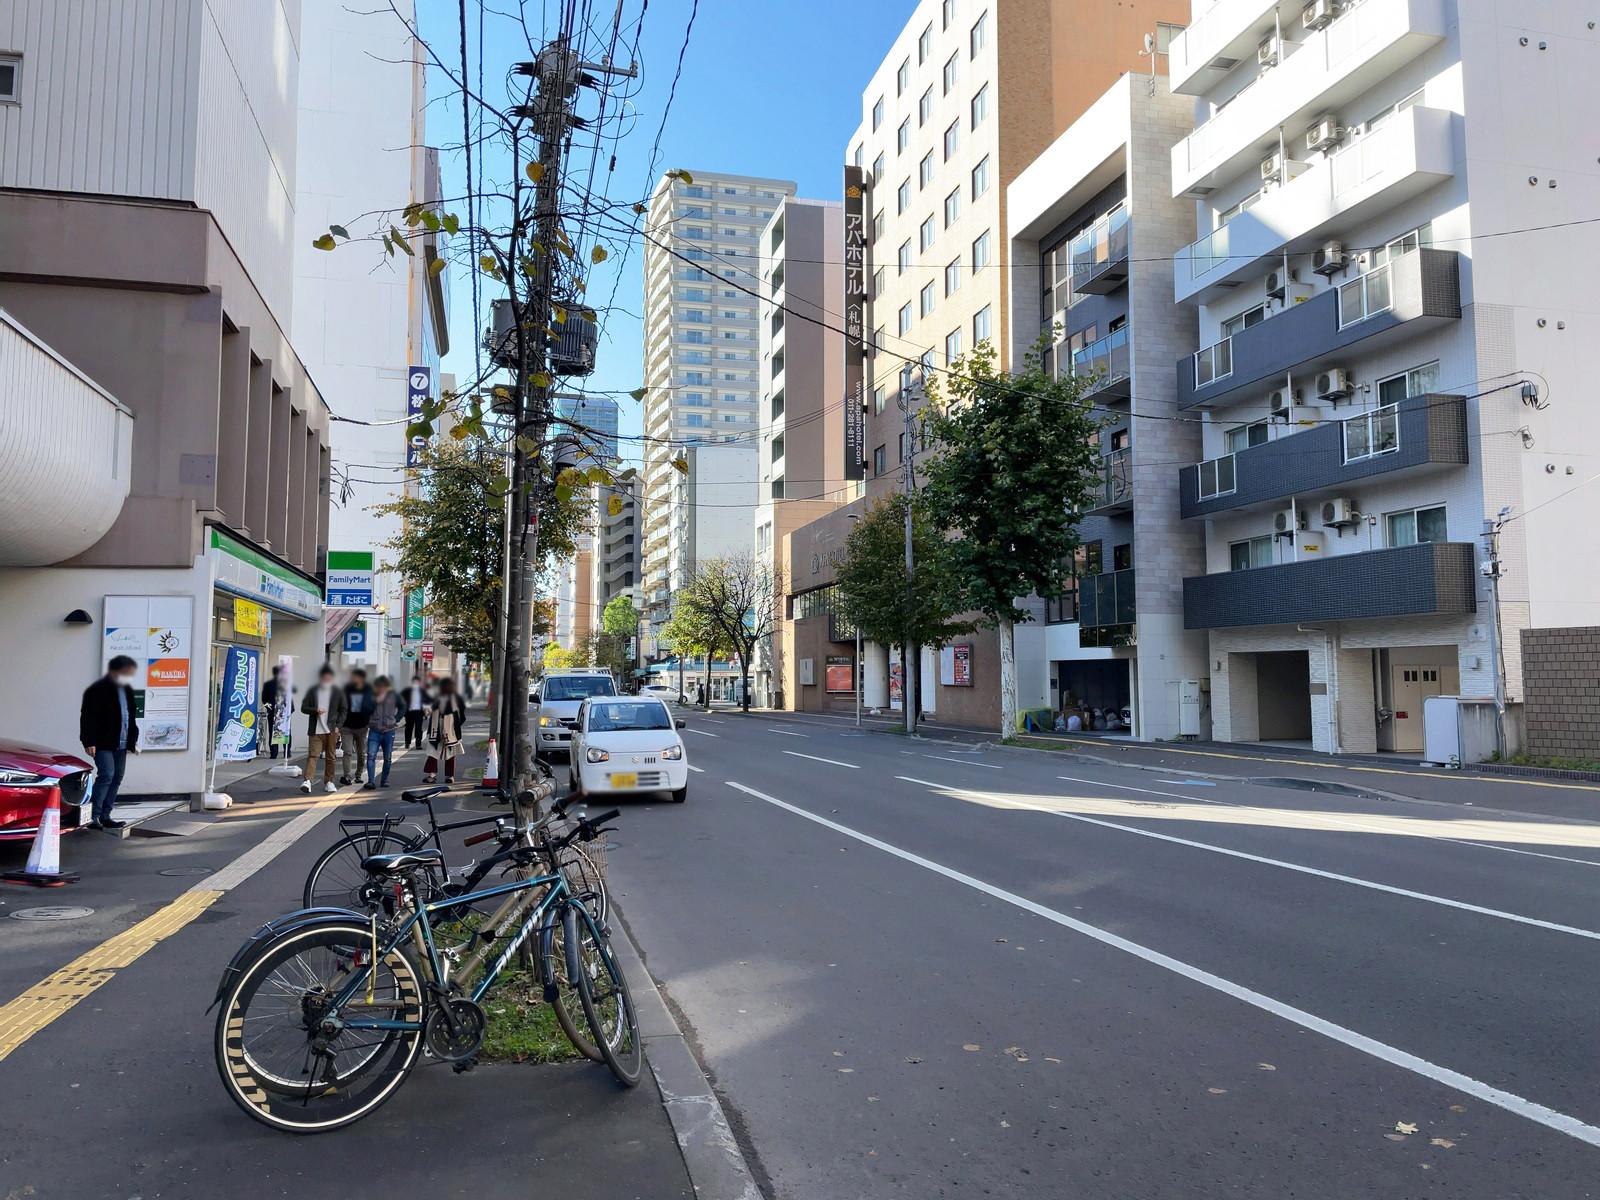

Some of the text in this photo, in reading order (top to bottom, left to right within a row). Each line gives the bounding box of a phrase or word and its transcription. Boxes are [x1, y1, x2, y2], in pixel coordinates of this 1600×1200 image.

[328, 575, 371, 585] FamilyMart
[331, 594, 368, 605] 酒 たばこ
[346, 632, 363, 649] P
[229, 650, 249, 719] ファミペイ
